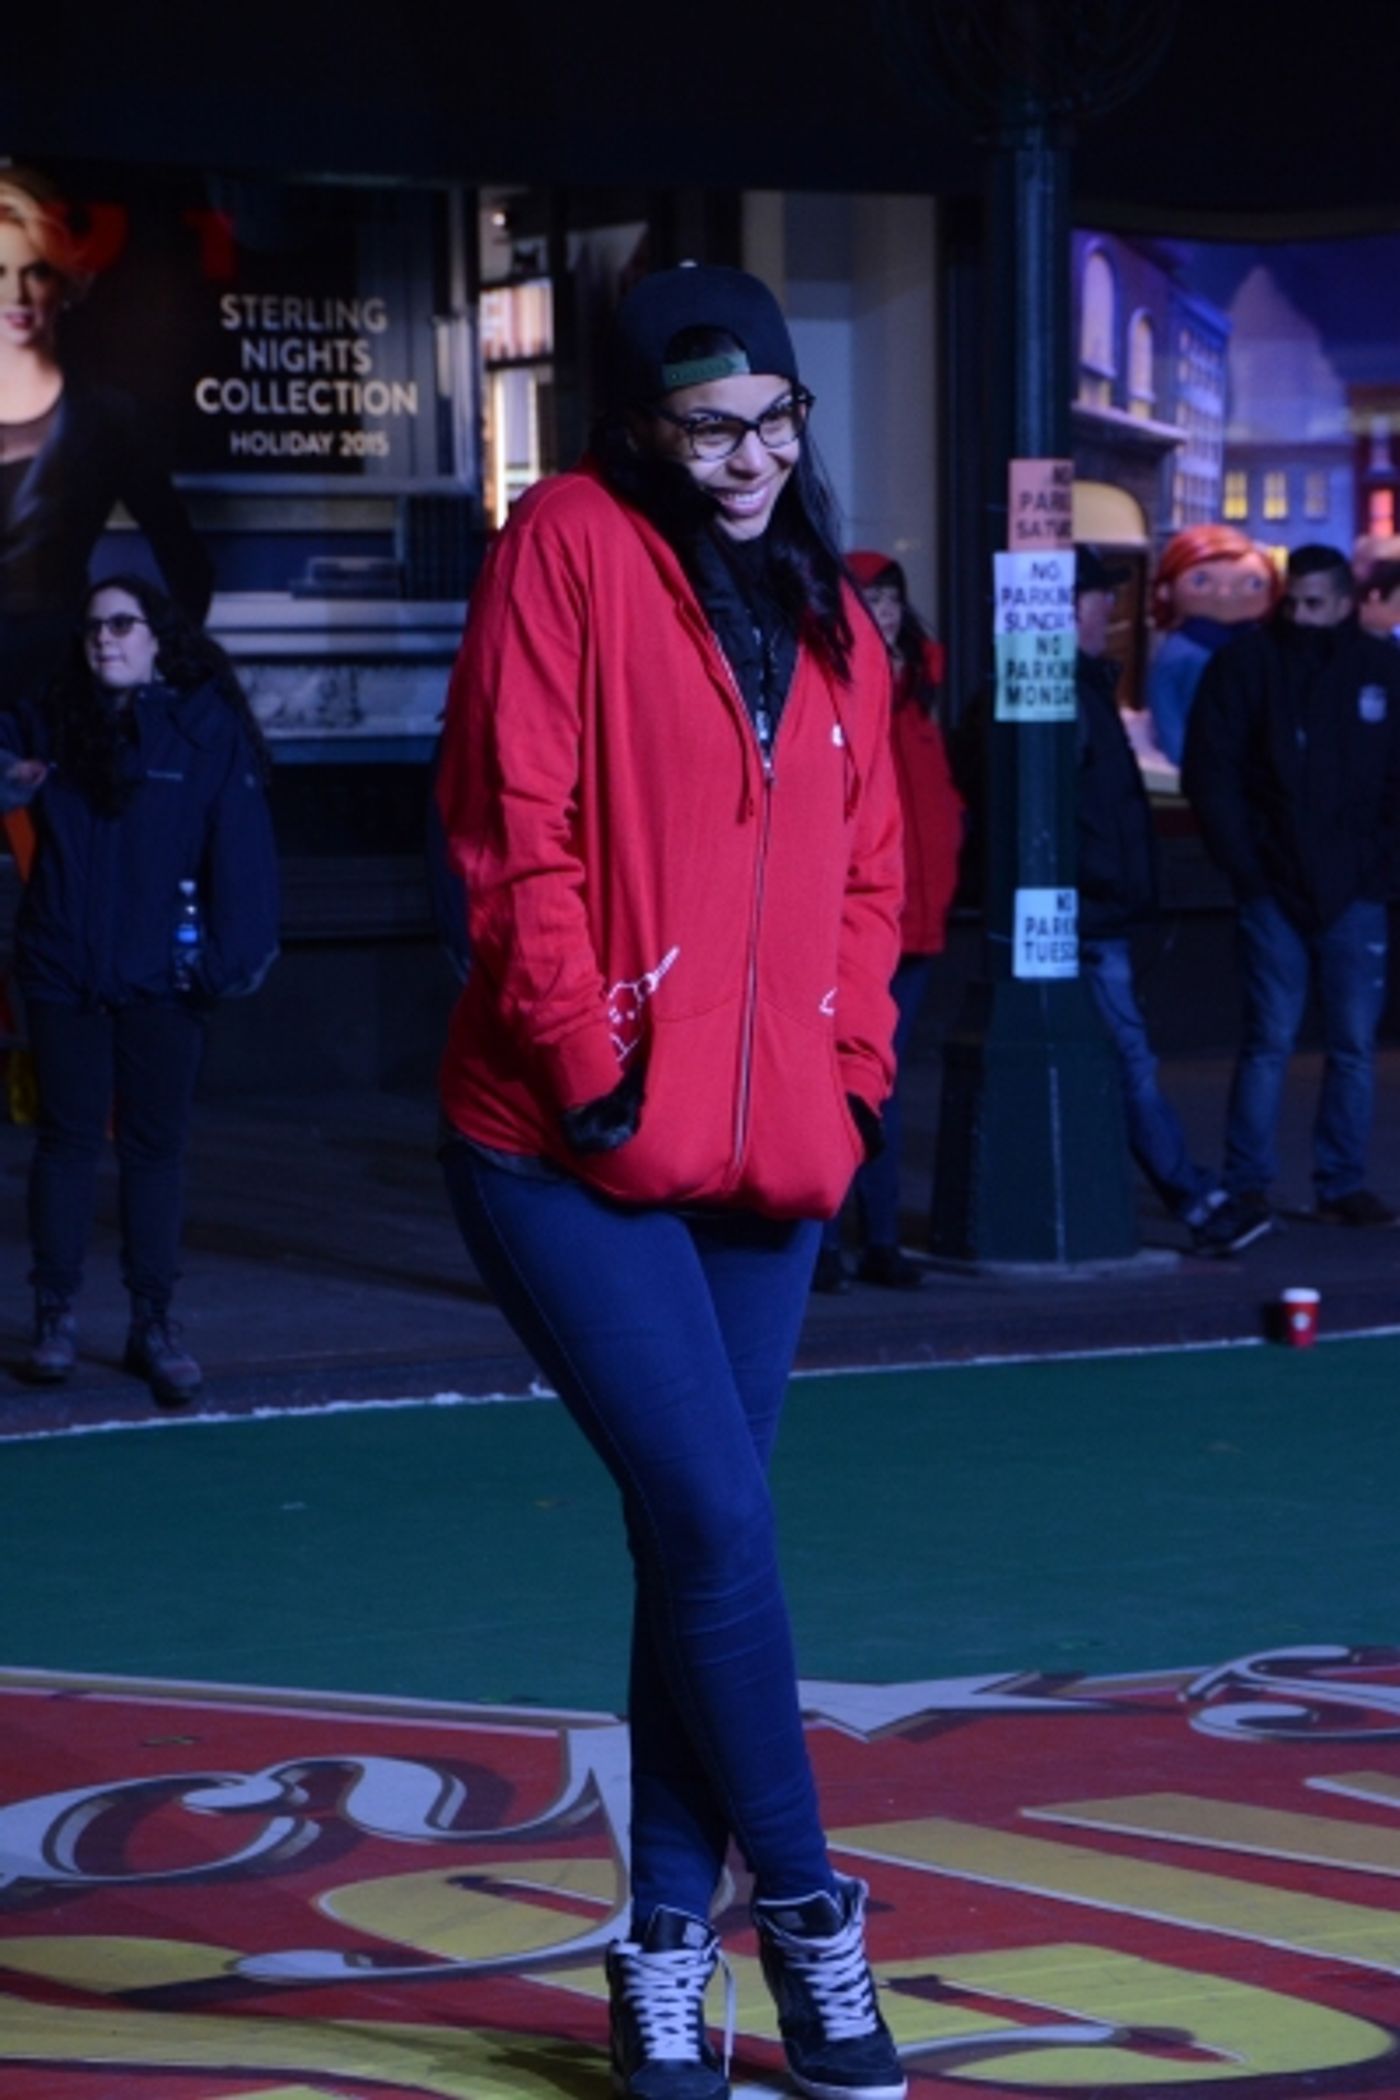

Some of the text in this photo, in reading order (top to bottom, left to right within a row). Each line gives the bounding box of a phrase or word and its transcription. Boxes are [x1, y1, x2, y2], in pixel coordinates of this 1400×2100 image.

[220, 294, 388, 334] STERLING
[240, 337, 373, 376] NIGHTS
[193, 376, 419, 417] COLLECTION
[229, 430, 390, 457] HOLIDAY 2015
[1031, 561, 1060, 580] NO
[1037, 637, 1061, 656] NO
